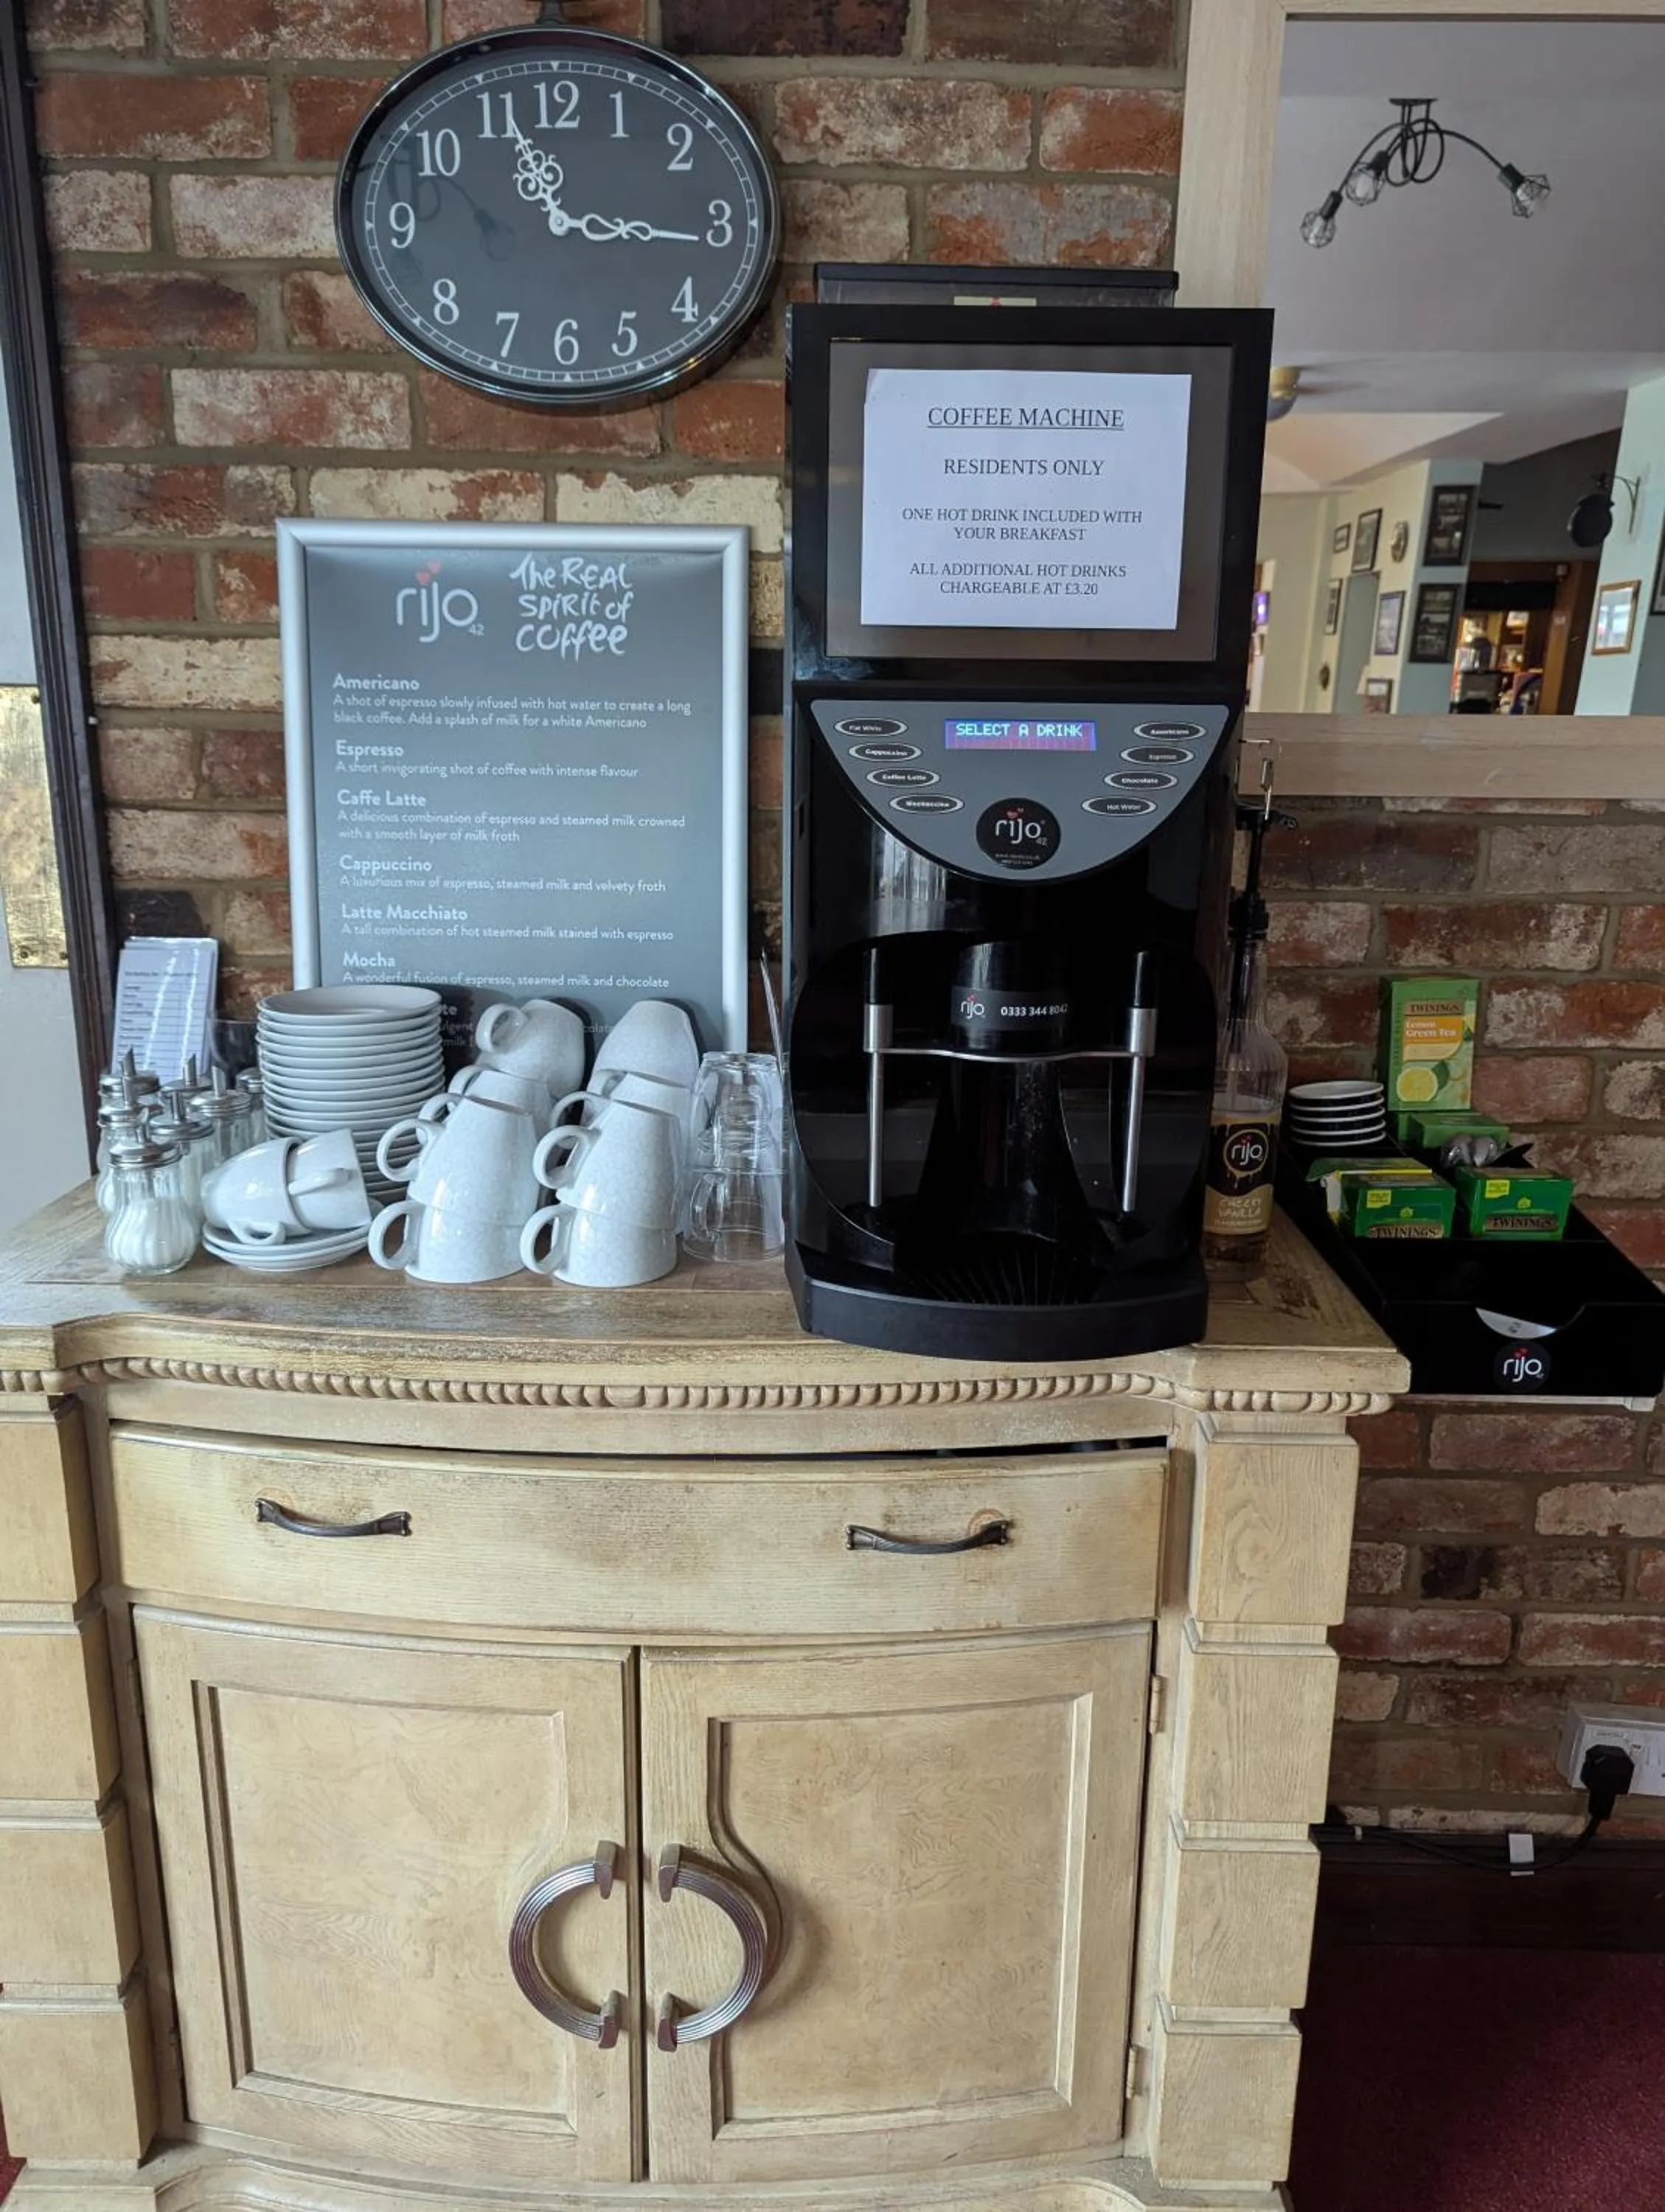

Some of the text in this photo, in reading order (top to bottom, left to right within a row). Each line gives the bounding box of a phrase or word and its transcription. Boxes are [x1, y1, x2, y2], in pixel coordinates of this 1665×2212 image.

[533, 80, 580, 128] 12
[609, 91, 630, 138] 1
[476, 91, 518, 139] 11
[416, 128, 461, 177] 10
[667, 123, 693, 170] 2
[388, 202, 415, 248] 9
[706, 200, 733, 247] 3
[432, 278, 459, 324] 8
[671, 276, 698, 322] 4
[496, 312, 519, 358] 7
[554, 319, 579, 365] 6
[611, 311, 638, 356] 5
[927, 407, 1125, 428] COFFEE MACHINE
[943, 459, 1105, 476] RESIDENTS ONLY
[902, 507, 1142, 524] ONE HOT DRINK INCLUDED WITH
[954, 526, 1086, 541] YOUR BREAKFAST
[510, 552, 633, 592] The REAL
[910, 563, 1127, 578] ALL ADDITIONAL HOT DRINKS
[939, 581, 1098, 596] CHARGEABLE AT £3.20
[395, 572, 478, 643] rijo
[605, 591, 634, 622] of
[333, 673, 420, 691] Americano
[333, 694, 691, 716] A shot of espresso slowly infused with hot water to create a long
[334, 710, 647, 728] black coffee. Add a splash of milk for a white Americano
[956, 723, 1083, 737] SELECT A DRINK
[336, 739, 404, 761] Espresso
[336, 761, 639, 779] A short invigorating shot of coffee with intense flavour
[337, 789, 427, 806] Caffe Latte
[338, 810, 685, 827] A delicious combination of espresso and steamed milk crowned
[338, 827, 520, 844] with a smooth layer of milk froth
[995, 815, 1041, 844] rijo
[339, 855, 432, 876] Cappuccino
[340, 875, 350, 886] A
[352, 875, 403, 887] luxurious
[406, 877, 425, 887] mix
[428, 876, 441, 888] of
[497, 877, 543, 890] steamed
[546, 878, 570, 890] milk
[573, 878, 592, 891] and
[596, 880, 635, 895] velvety
[638, 880, 666, 892] froth
[341, 902, 468, 921] Latte Macchiato
[341, 923, 674, 943] A tall combination of hot steamed milk stained with espresso
[342, 951, 395, 967] Mocha
[342, 971, 670, 988] A wonderful fusion of espresso, steamed milk and chocolate
[961, 998, 985, 1019] rijo
[1001, 1006, 1026, 1017] 0333
[1029, 1006, 1047, 1016] 344
[1410, 1003, 1460, 1012] TWININGS
[1406, 1029, 1456, 1037] Green Tea
[1231, 1139, 1262, 1166] rijo
[1375, 1226, 1439, 1238] TWININGS
[1492, 1217, 1553, 1229] TWININGS
[1504, 1353, 1542, 1382] rijo
